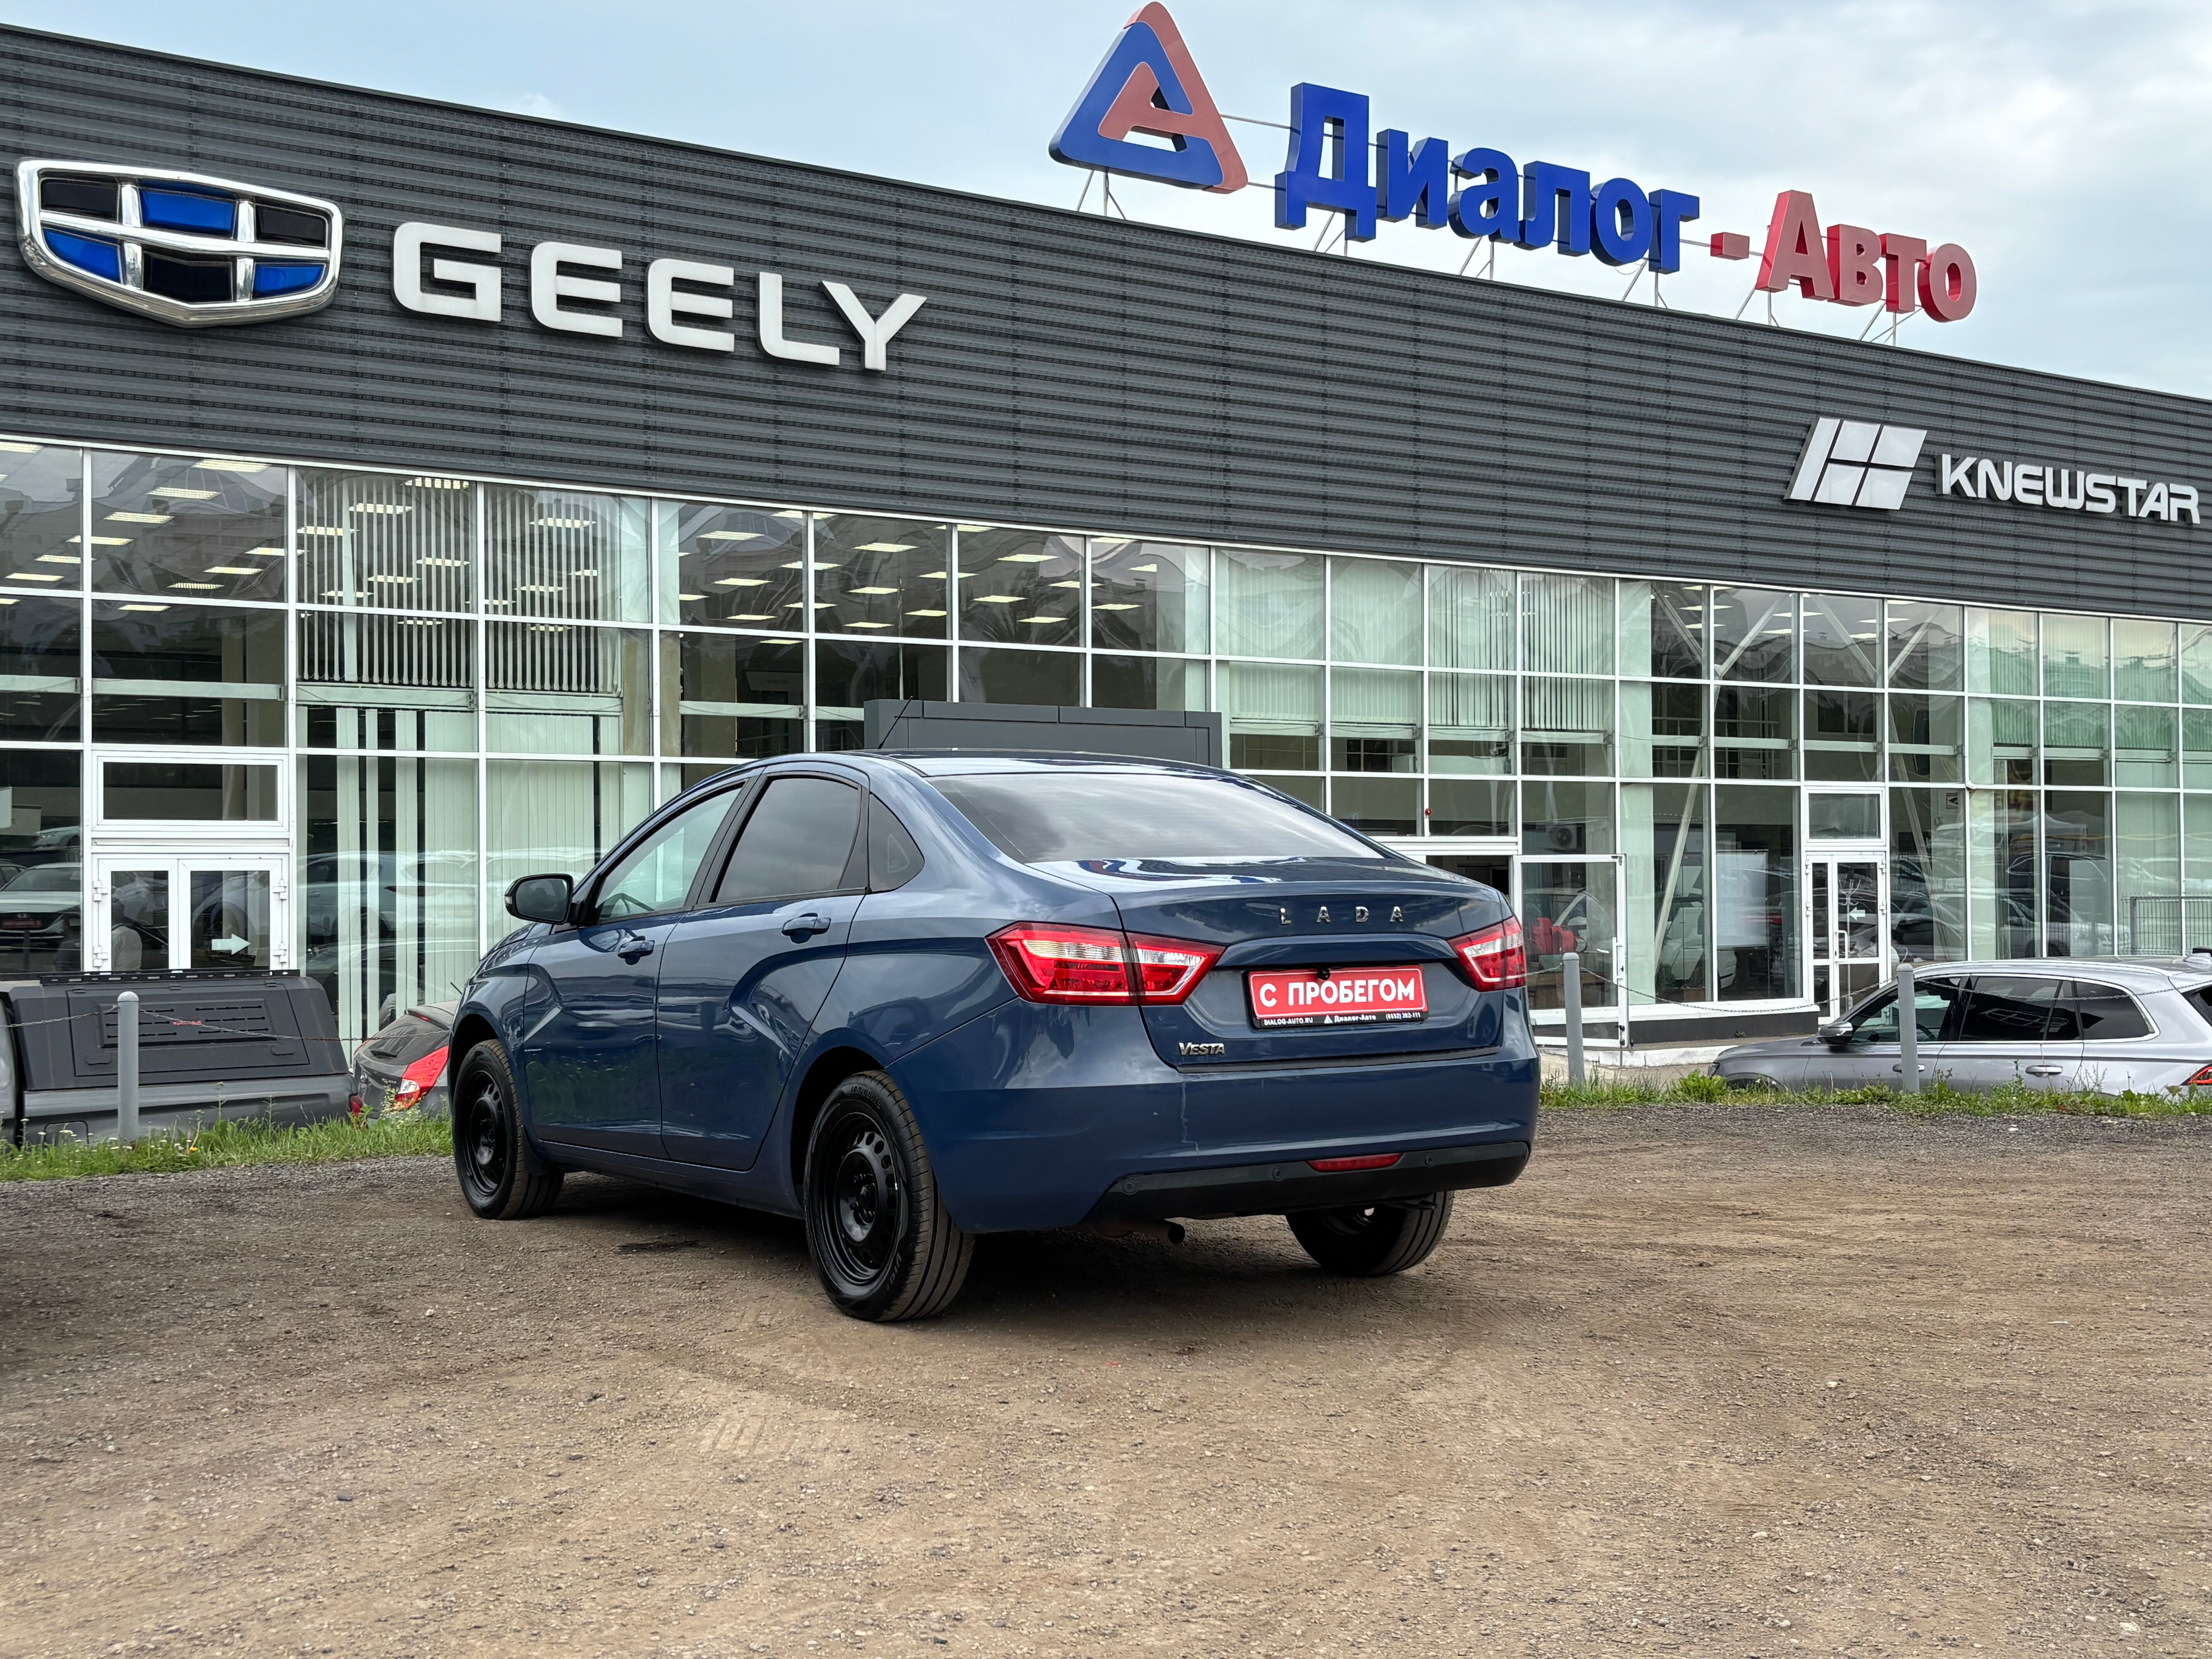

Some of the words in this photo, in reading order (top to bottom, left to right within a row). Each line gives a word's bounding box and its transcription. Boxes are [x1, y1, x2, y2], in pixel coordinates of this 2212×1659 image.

[1275, 82, 1977, 323] Диалог-Авто
[392, 221, 927, 371] GEELY
[1938, 454, 2201, 525] KNEWSTAR
[1279, 906, 1403, 924] LADA
[1259, 983, 1277, 1007] С
[1288, 977, 1415, 1006] ПРОБЕГОМ
[1179, 1042, 1225, 1056] VESTA
